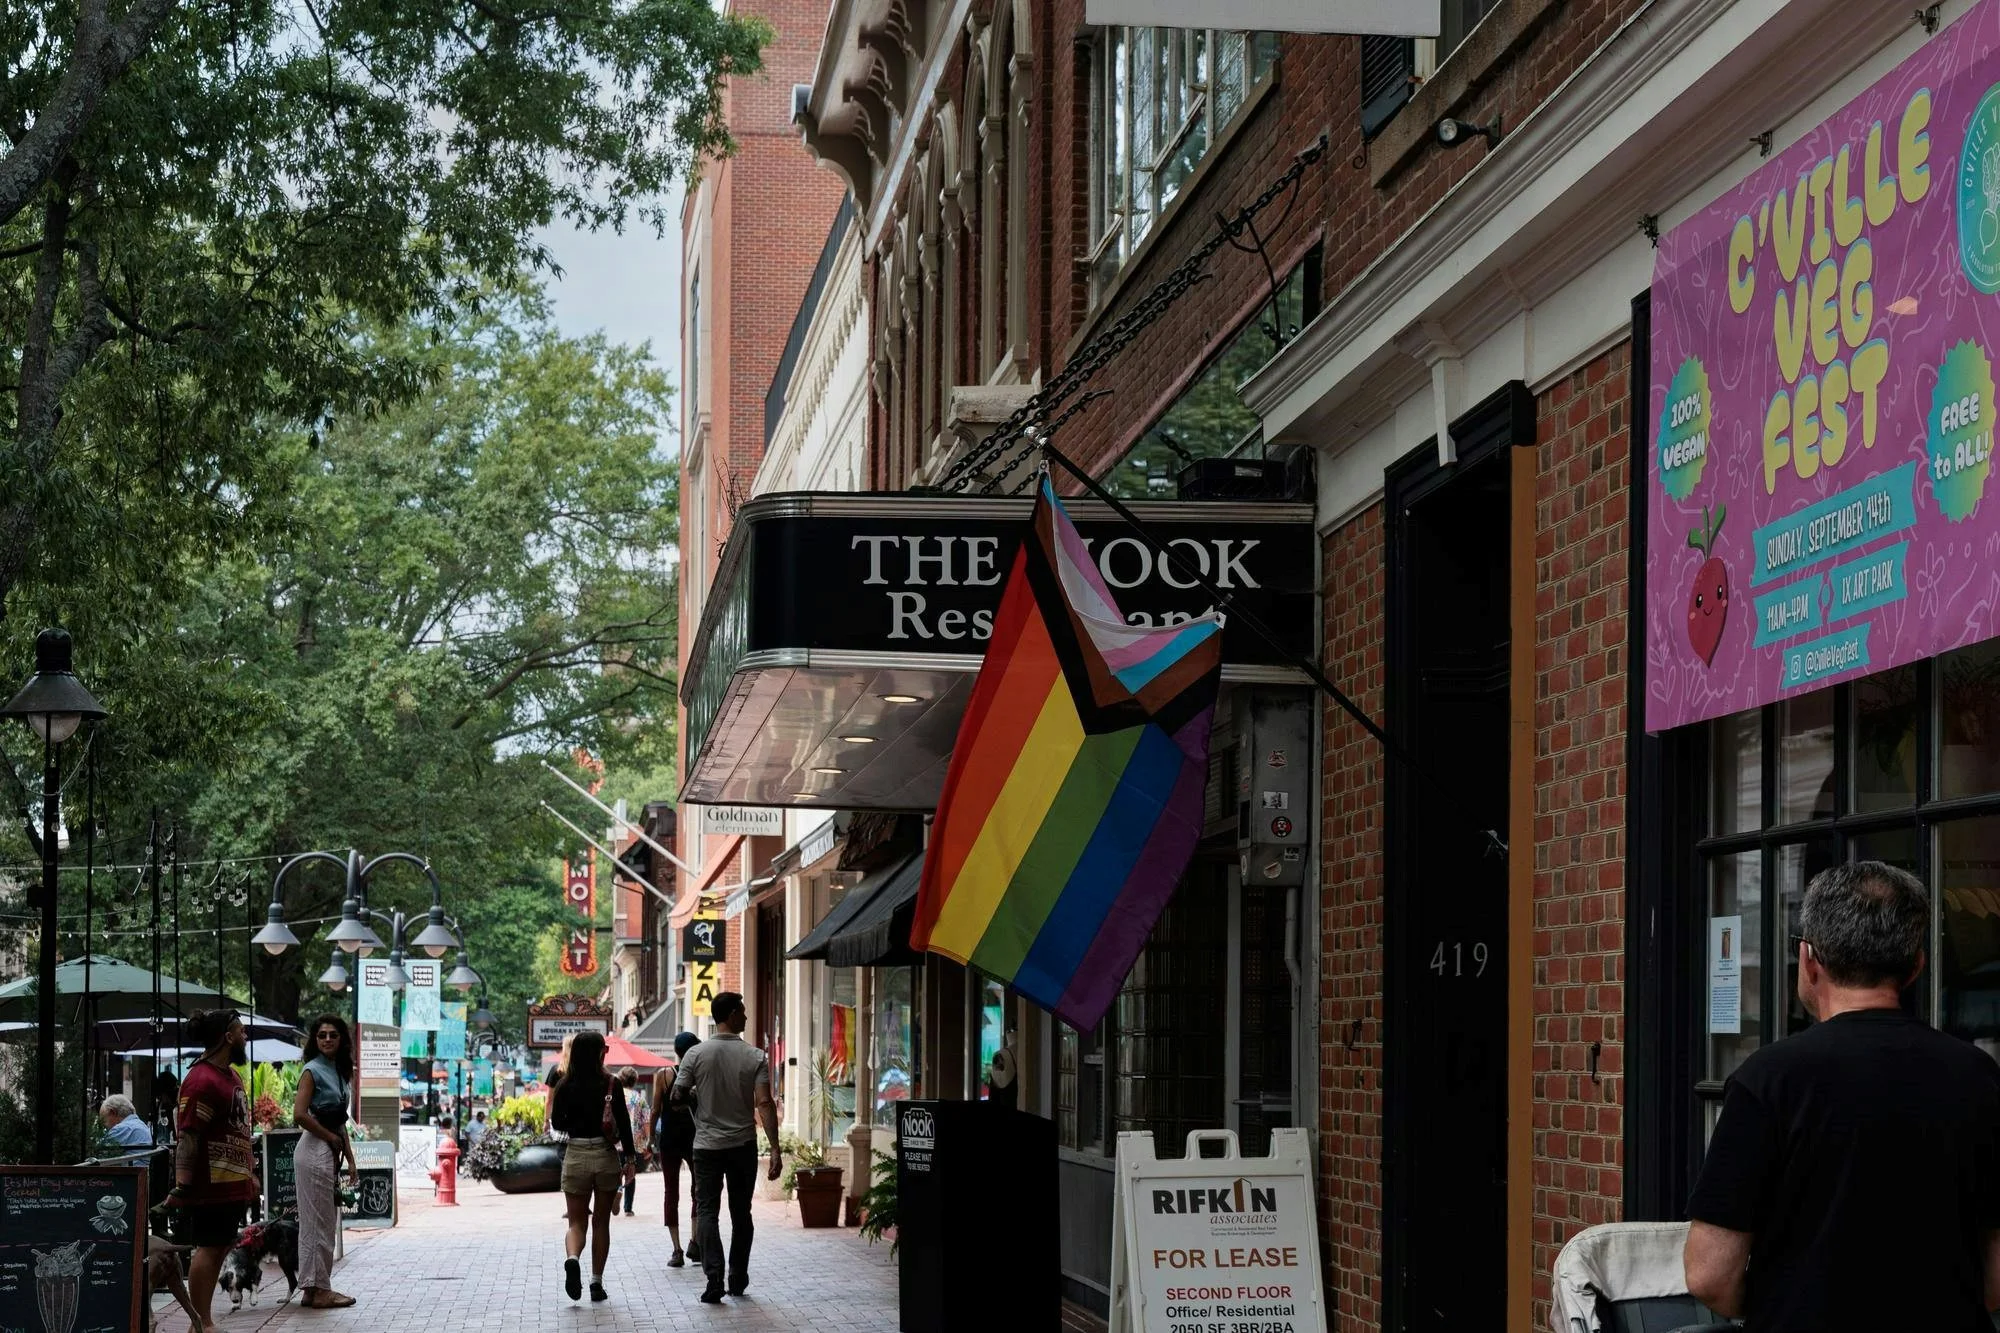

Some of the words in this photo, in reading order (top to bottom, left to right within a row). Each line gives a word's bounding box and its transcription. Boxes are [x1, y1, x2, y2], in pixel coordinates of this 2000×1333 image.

[1728, 87, 1931, 314] C'VILLE
[1774, 238, 1873, 384] VEG
[1670, 392, 1702, 429] 100%
[1763, 337, 1888, 496] FEST
[1940, 392, 1980, 437] FREE
[1662, 430, 1706, 471] VEGAN
[1934, 452, 1952, 480] to
[1954, 430, 1989, 473] ALL!
[1766, 525, 1807, 571] SUNDAY,
[1808, 500, 1864, 553] SEPTEMBER
[1866, 490, 1892, 530] 14th
[852, 535, 1001, 585] THE
[1085, 537, 1262, 589] OOK
[1841, 576, 1851, 605] IX
[1852, 568, 1870, 601] ART
[1871, 559, 1894, 594] PARK
[707, 806, 779, 824] Goldman
[1430, 941, 1488, 978] 419
[905, 1116, 932, 1137] NOOK
[905, 1151, 921, 1161] PLEASE
[921, 1153, 932, 1163] WAIT
[1152, 1177, 1278, 1215] RIFKIN
[1209, 1213, 1278, 1226] associates
[1154, 1249, 1207, 1269] FOR
[1214, 1247, 1299, 1268] LEASE
[1166, 1287, 1233, 1301] SECOND
[1237, 1285, 1292, 1300] FLOOR
[1166, 1304, 1212, 1319] Office/
[1216, 1303, 1295, 1317] Residential
[1170, 1324, 1203, 1333] 2050
[1208, 1323, 1225, 1333] SF
[1231, 1321, 1295, 1333] 3BR/2BA
